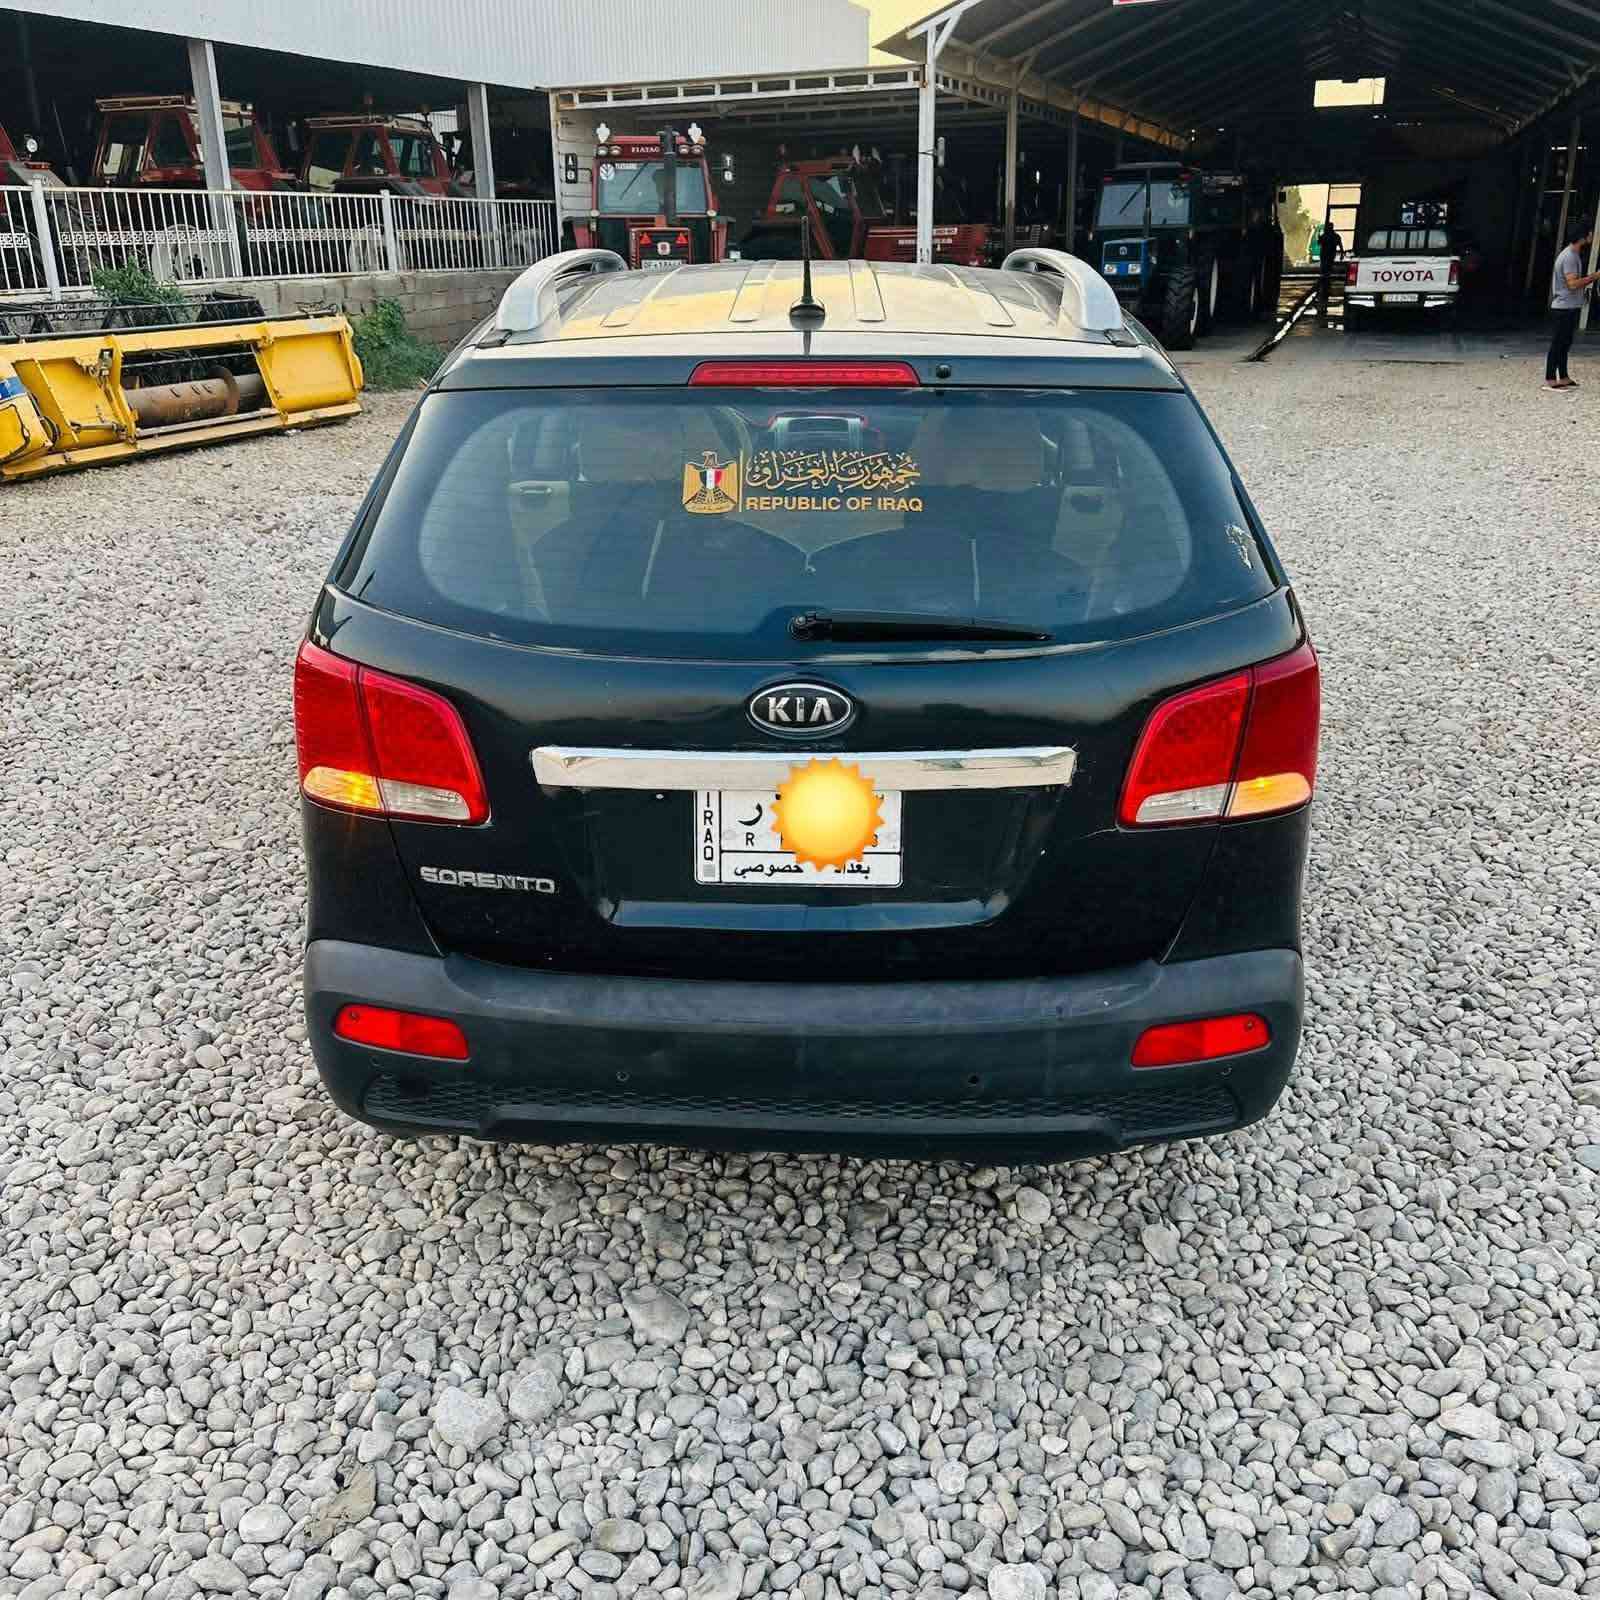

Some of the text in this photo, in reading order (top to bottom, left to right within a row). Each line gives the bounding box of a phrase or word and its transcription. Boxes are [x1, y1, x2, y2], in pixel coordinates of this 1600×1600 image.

[1371, 270, 1434, 282] TOYOTA
[746, 497, 841, 511] REPUBLIC
[846, 497, 873, 511] OF
[878, 497, 923, 512] IRAQ
[767, 696, 834, 722] KIA
[703, 791, 715, 861] IRAQ
[420, 866, 556, 894] SORENTO
